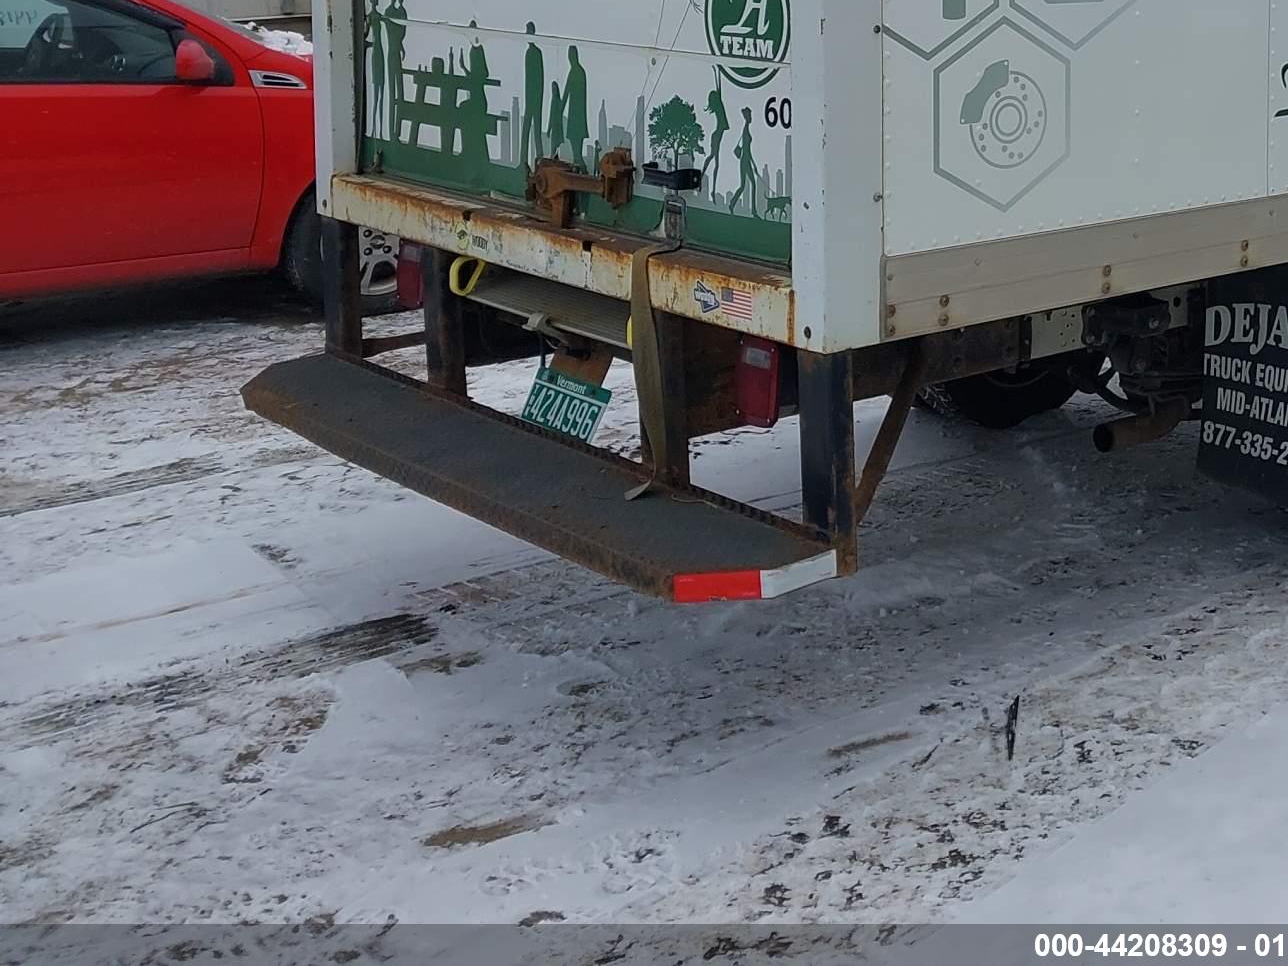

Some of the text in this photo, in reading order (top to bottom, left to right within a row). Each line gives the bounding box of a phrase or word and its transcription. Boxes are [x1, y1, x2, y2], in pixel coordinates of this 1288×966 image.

[719, 35, 774, 59] TEAM
[1203, 353, 1252, 385] TRUCK
[556, 374, 587, 395] Vermont
[529, 386, 599, 440] 424A996
